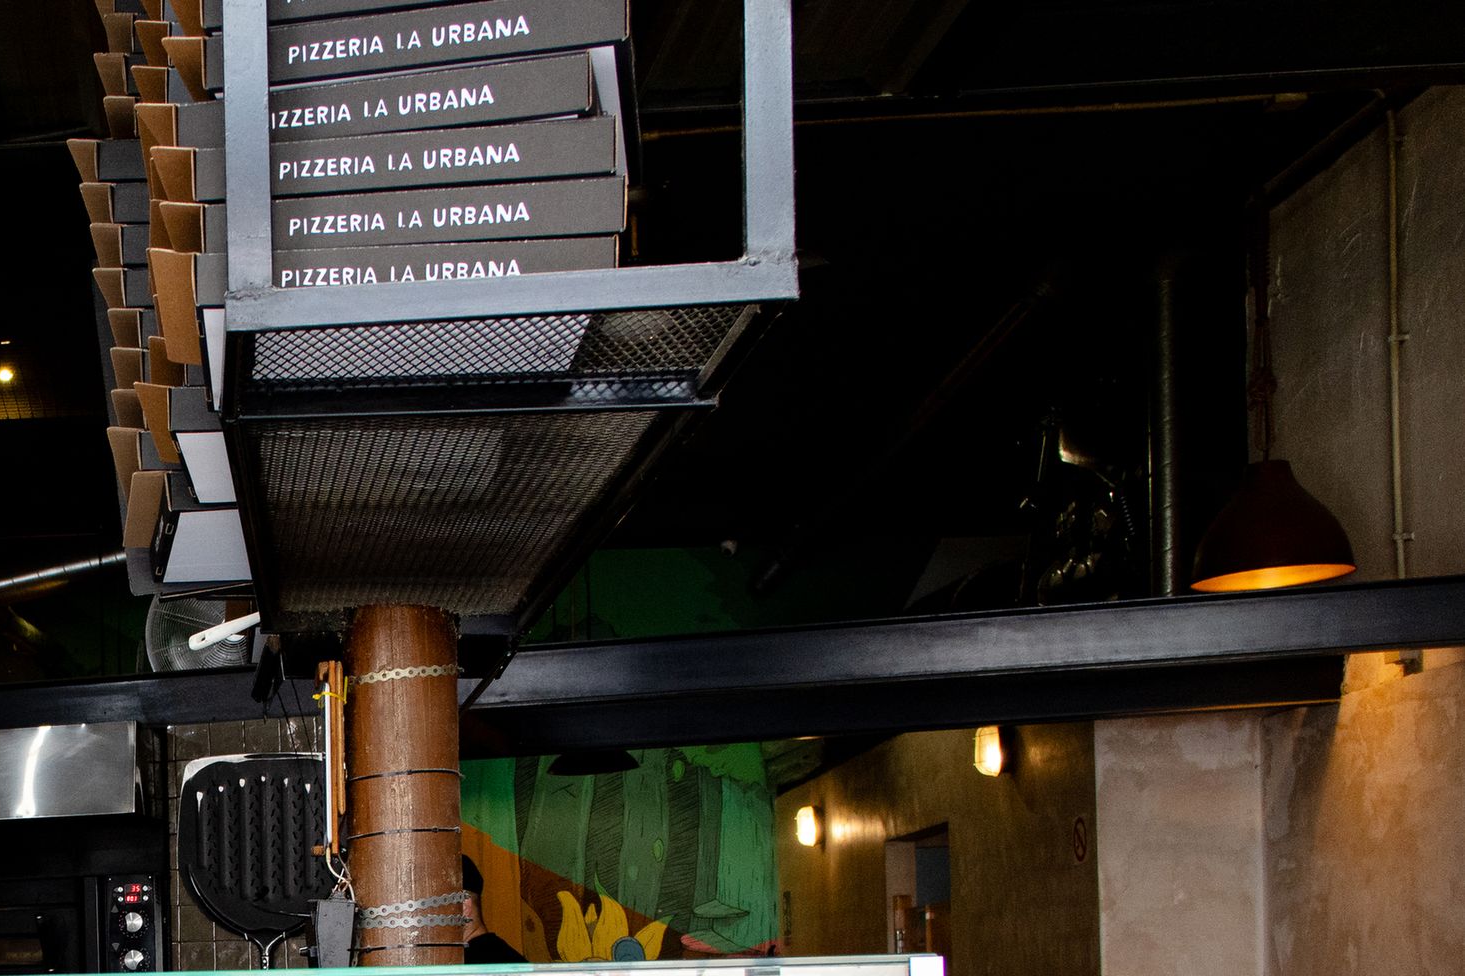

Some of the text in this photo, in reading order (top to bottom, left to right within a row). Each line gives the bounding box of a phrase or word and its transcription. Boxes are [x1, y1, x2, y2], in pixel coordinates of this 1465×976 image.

[288, 16, 529, 64] PIZZERIA LA URBANA
[272, 85, 494, 130] IZZERIA LA URBANA
[279, 143, 520, 180] PIZZERIA LA URBANA
[289, 202, 529, 236] PIZZERIA LA URBANA
[281, 259, 521, 288] PIZZERIA LA URBANA
